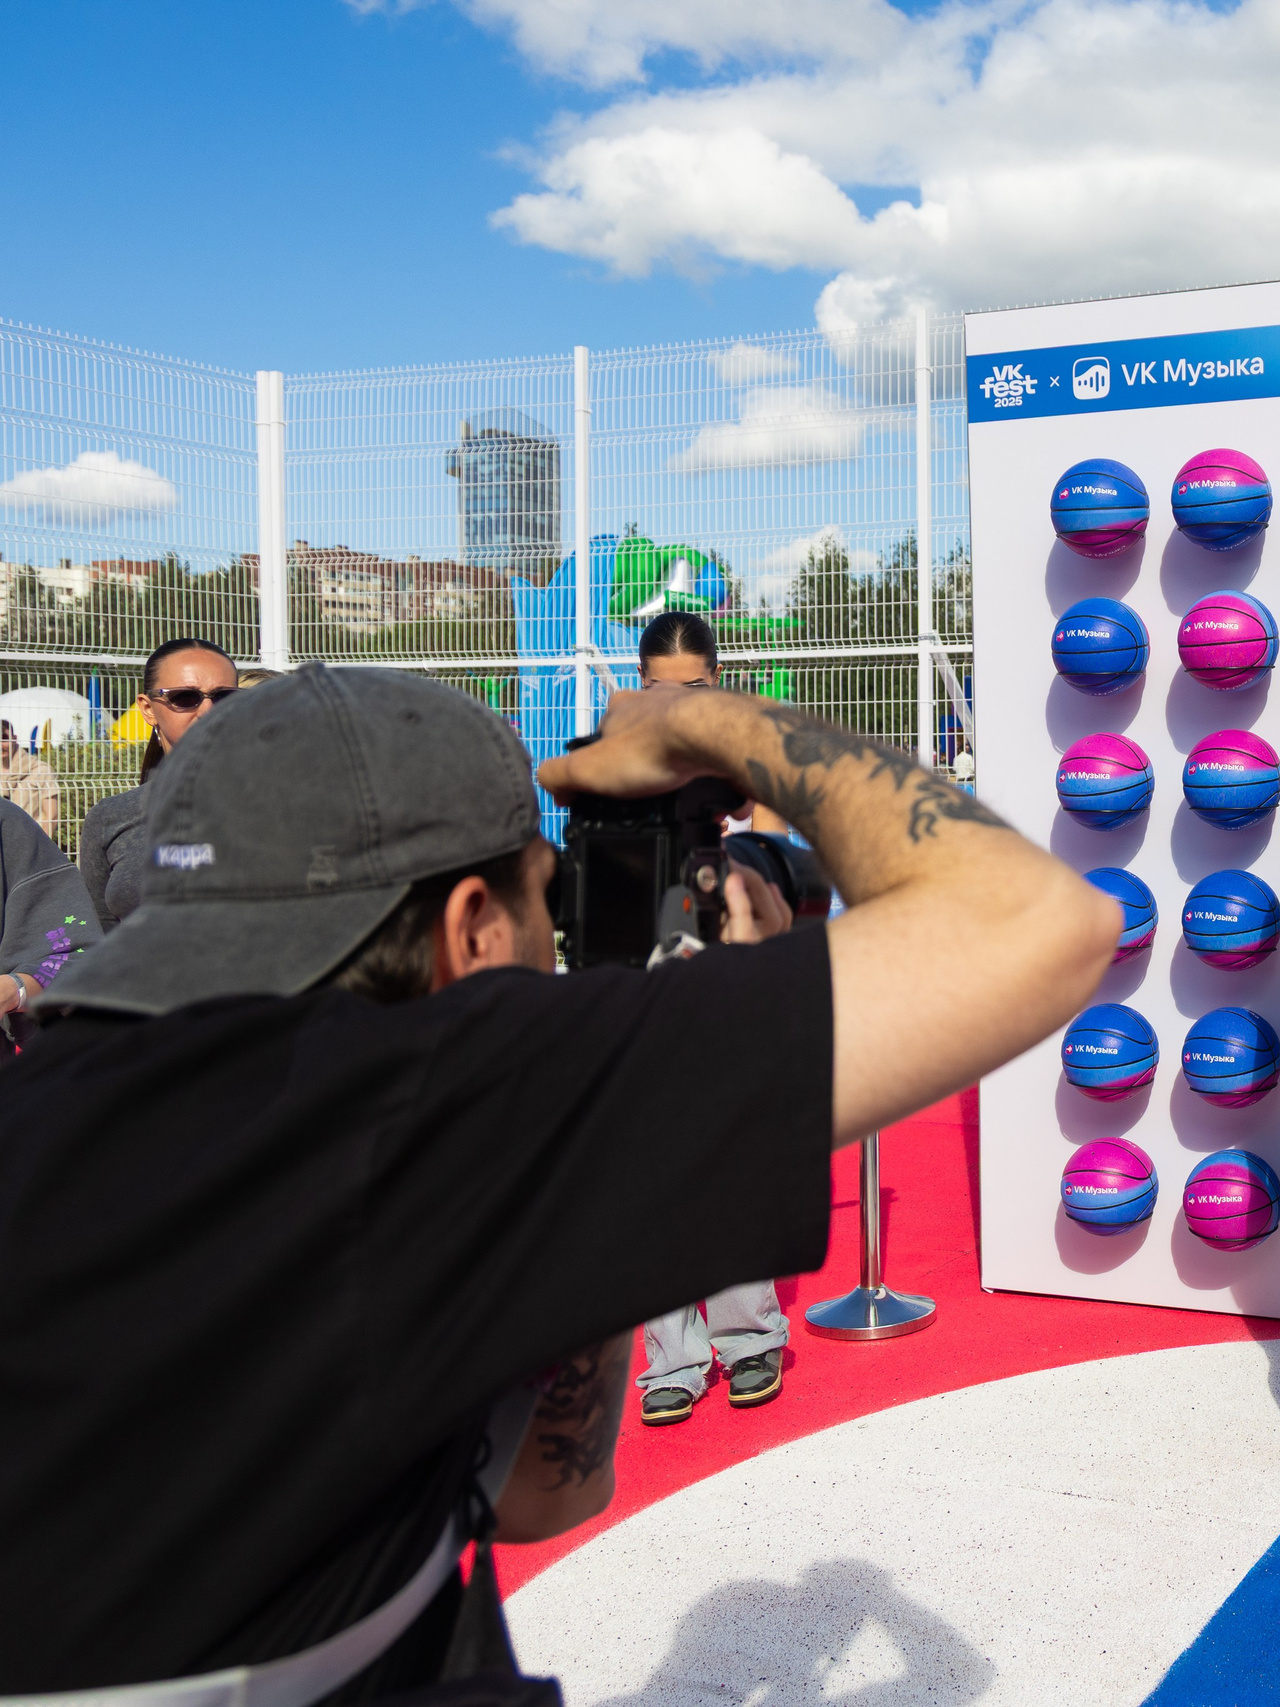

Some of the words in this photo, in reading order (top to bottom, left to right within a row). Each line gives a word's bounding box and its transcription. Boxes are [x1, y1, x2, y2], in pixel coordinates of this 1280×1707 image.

[992, 364, 1024, 381] VK
[1121, 361, 1157, 386] VK
[1164, 356, 1264, 387] Музыка
[979, 374, 1038, 398] fest
[994, 397, 1023, 408] 2025
[1189, 480, 1200, 489] VK
[1202, 478, 1236, 488] Музыка
[1072, 486, 1082, 494] VK
[1084, 486, 1117, 495] Музыка
[1205, 621, 1238, 630] Музыка
[1078, 629, 1109, 638] Музыка
[1199, 762, 1209, 770] VK
[1210, 762, 1244, 771] Музыка
[1078, 772, 1110, 780] Музыка
[1205, 912, 1238, 922] Музыка
[1086, 1045, 1117, 1054] Музыка
[1203, 1054, 1234, 1063] Музыка
[1086, 1186, 1118, 1195] Музыка
[1209, 1196, 1242, 1204] Музыка
